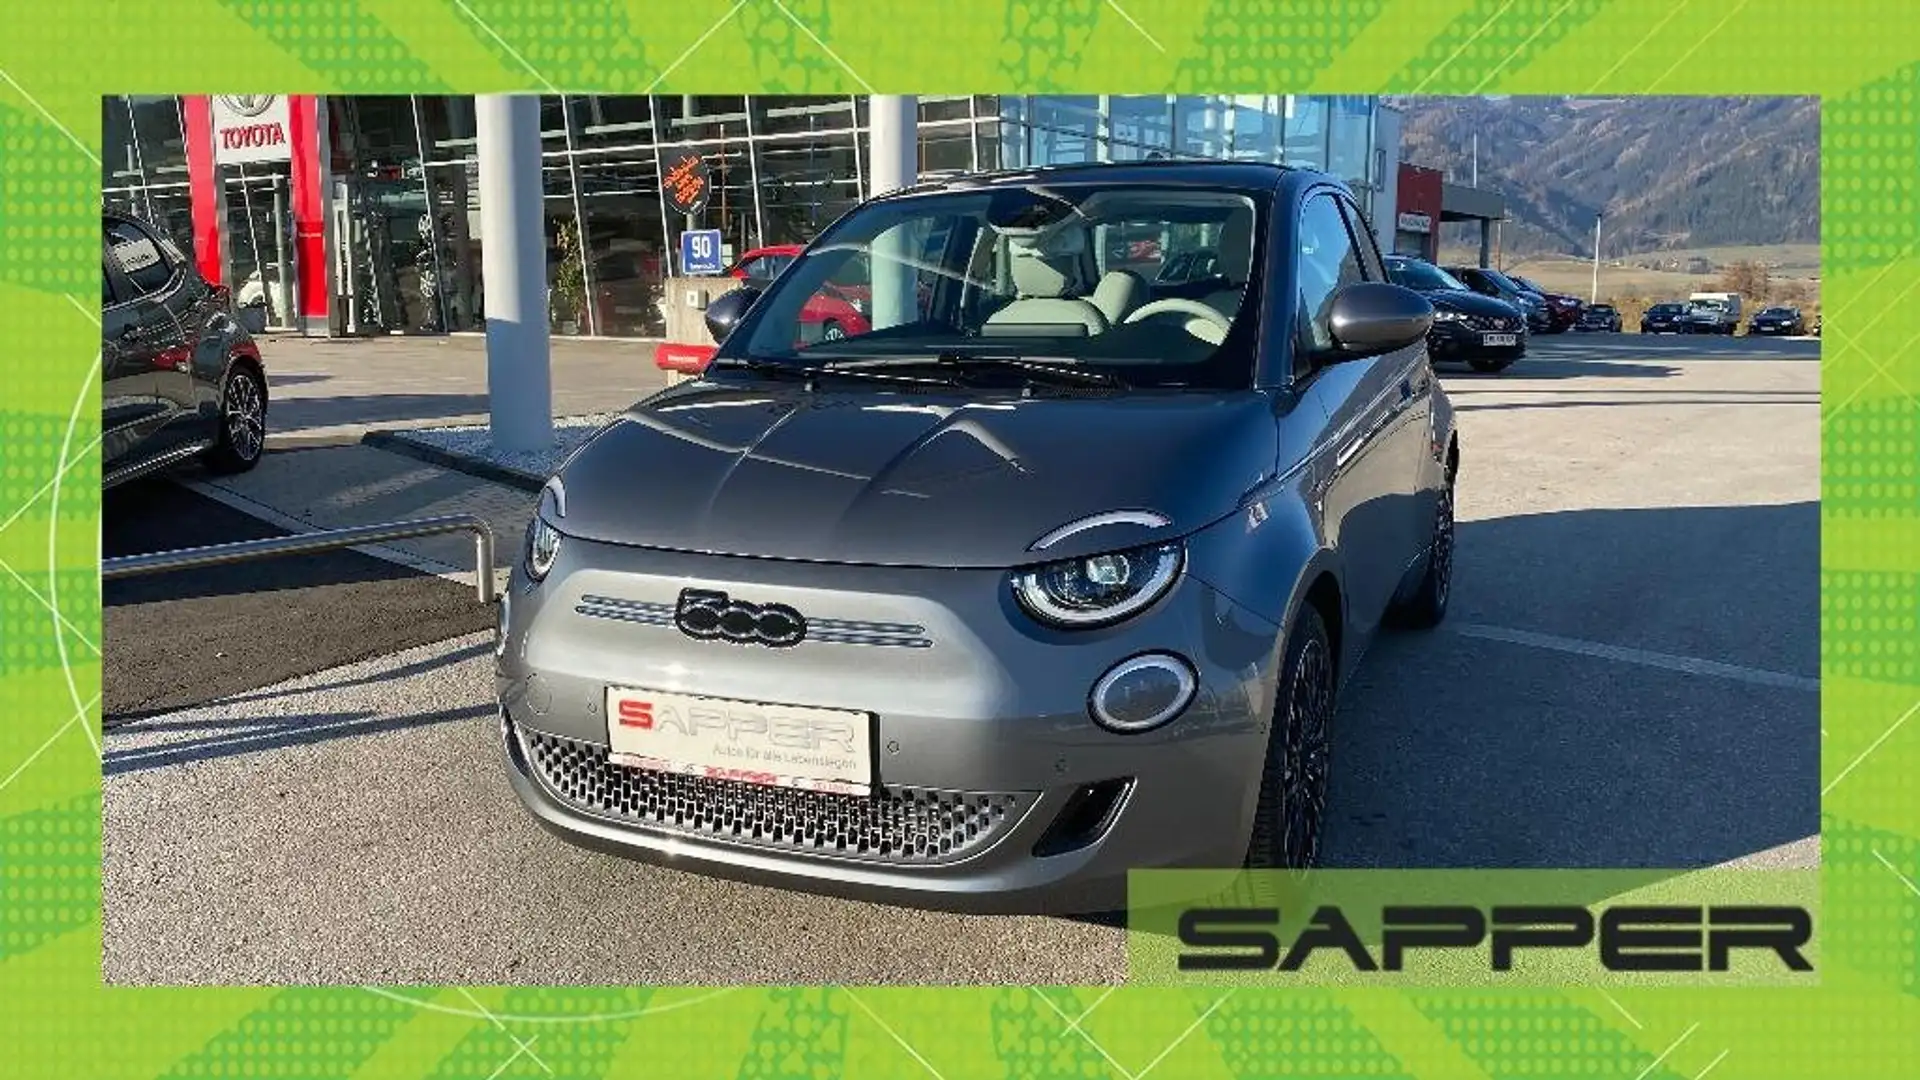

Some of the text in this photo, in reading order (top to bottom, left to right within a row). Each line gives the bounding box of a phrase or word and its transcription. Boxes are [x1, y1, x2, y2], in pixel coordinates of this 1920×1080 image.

[220, 122, 286, 149] TOYOTA
[691, 235, 711, 258] 90
[676, 587, 807, 648] 500
[618, 699, 856, 753] SAPPER
